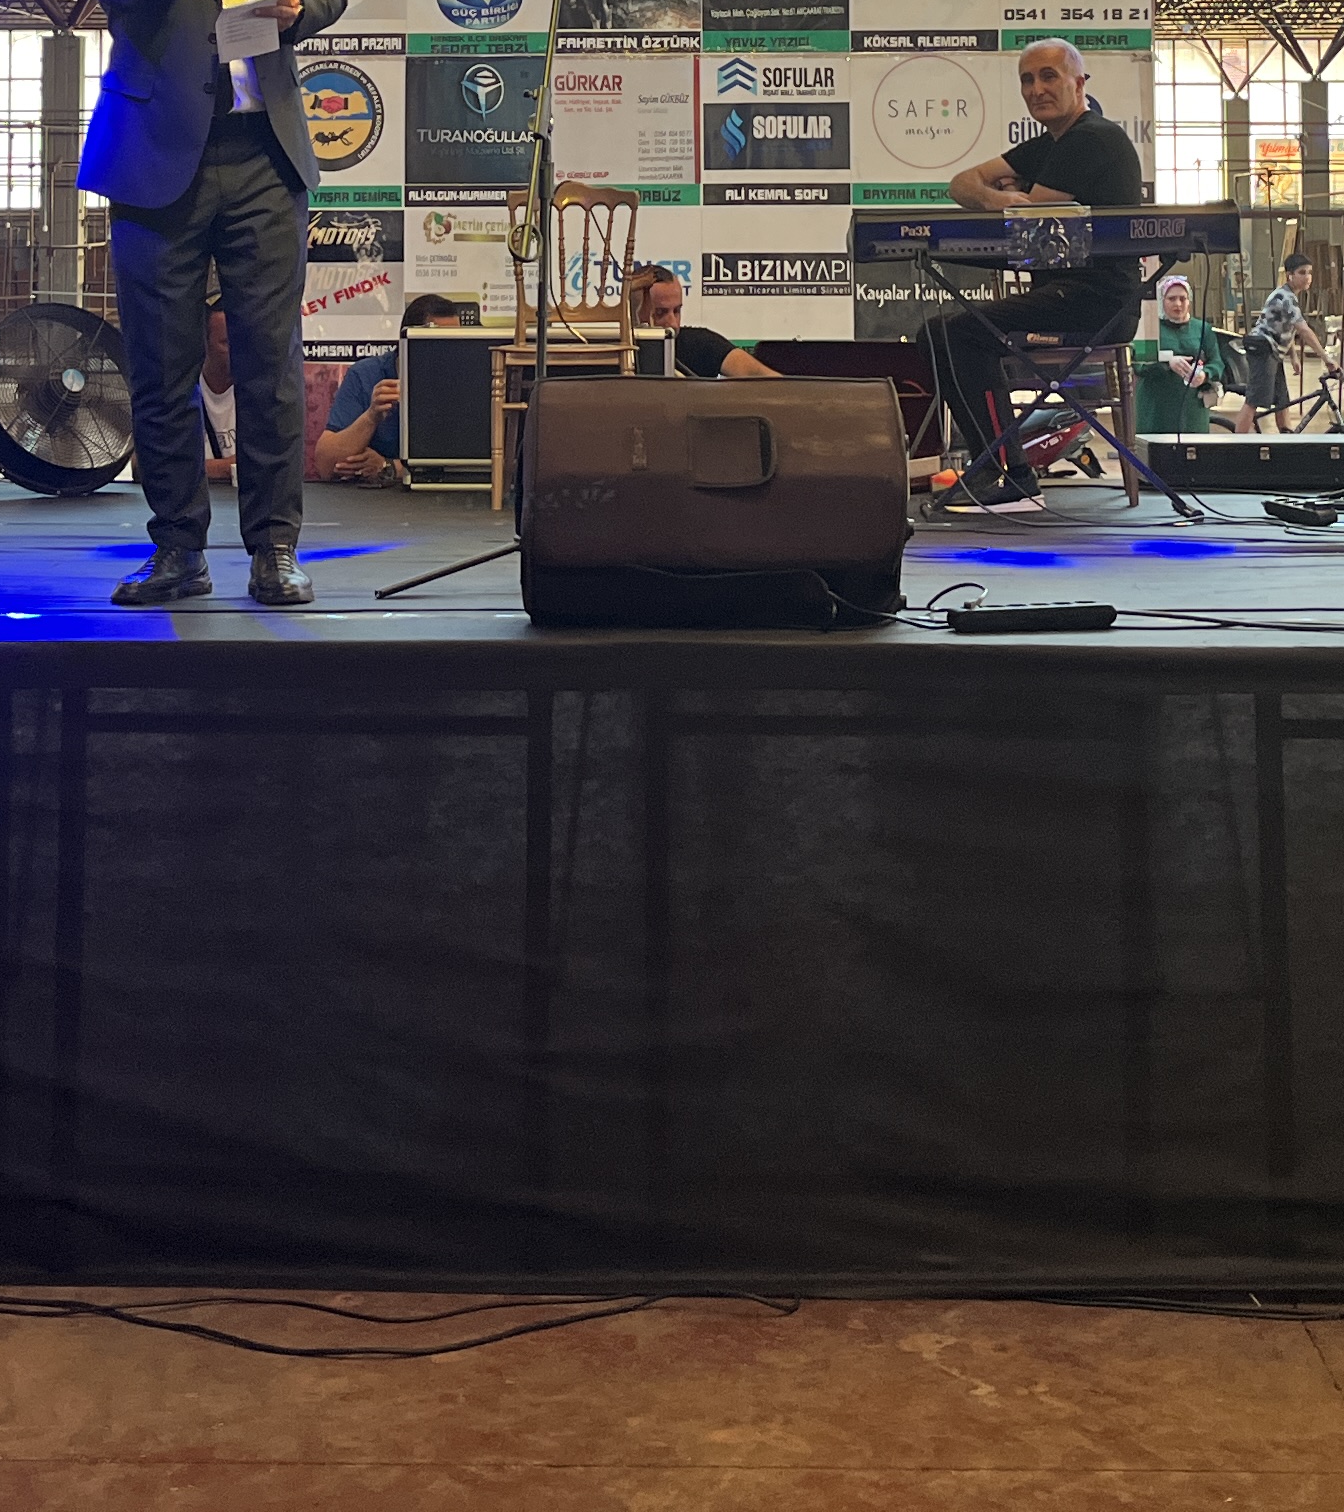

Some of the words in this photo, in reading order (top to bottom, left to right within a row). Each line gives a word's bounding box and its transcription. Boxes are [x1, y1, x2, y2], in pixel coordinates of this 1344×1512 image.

[451, 7, 477, 18] GÜÇ
[481, 2, 519, 16] BİRLİĞİ
[1004, 9, 1047, 20] 0541
[1060, 9, 1095, 20] 364
[1102, 9, 1123, 20] 18
[1129, 8, 1149, 20] 21
[465, 13, 510, 26] PARTİSİ
[332, 38, 357, 51] GIDA
[362, 38, 402, 50] PAZARI
[557, 35, 637, 48] FAHRETTİN
[642, 35, 700, 48] ÖZTÜRK
[725, 38, 764, 49] YAVUZ
[770, 37, 811, 48] YAZICI
[863, 35, 914, 48] KÖKSAL
[917, 35, 977, 48] ALEMDAR
[1075, 34, 1128, 46] BEKAR
[431, 44, 480, 54] SEDAT
[486, 42, 529, 54] TERZİ
[555, 71, 622, 91] GÜRKAR
[762, 67, 835, 88] SOFULAR
[753, 115, 832, 139] SOFULAR
[417, 128, 536, 143] TURANOĞULLAR
[312, 191, 350, 206] YAŞAR
[353, 189, 401, 203] DEMİREL
[725, 187, 745, 201] ALİ
[748, 187, 792, 201] KEMAL
[794, 187, 829, 201] SOFU
[862, 189, 916, 200] BAYRAM
[900, 225, 931, 238] Pa3X
[1129, 218, 1185, 239] KORG
[333, 272, 391, 304] FINDIK
[783, 287, 817, 295] Limited
[856, 284, 911, 308] Kayalar
